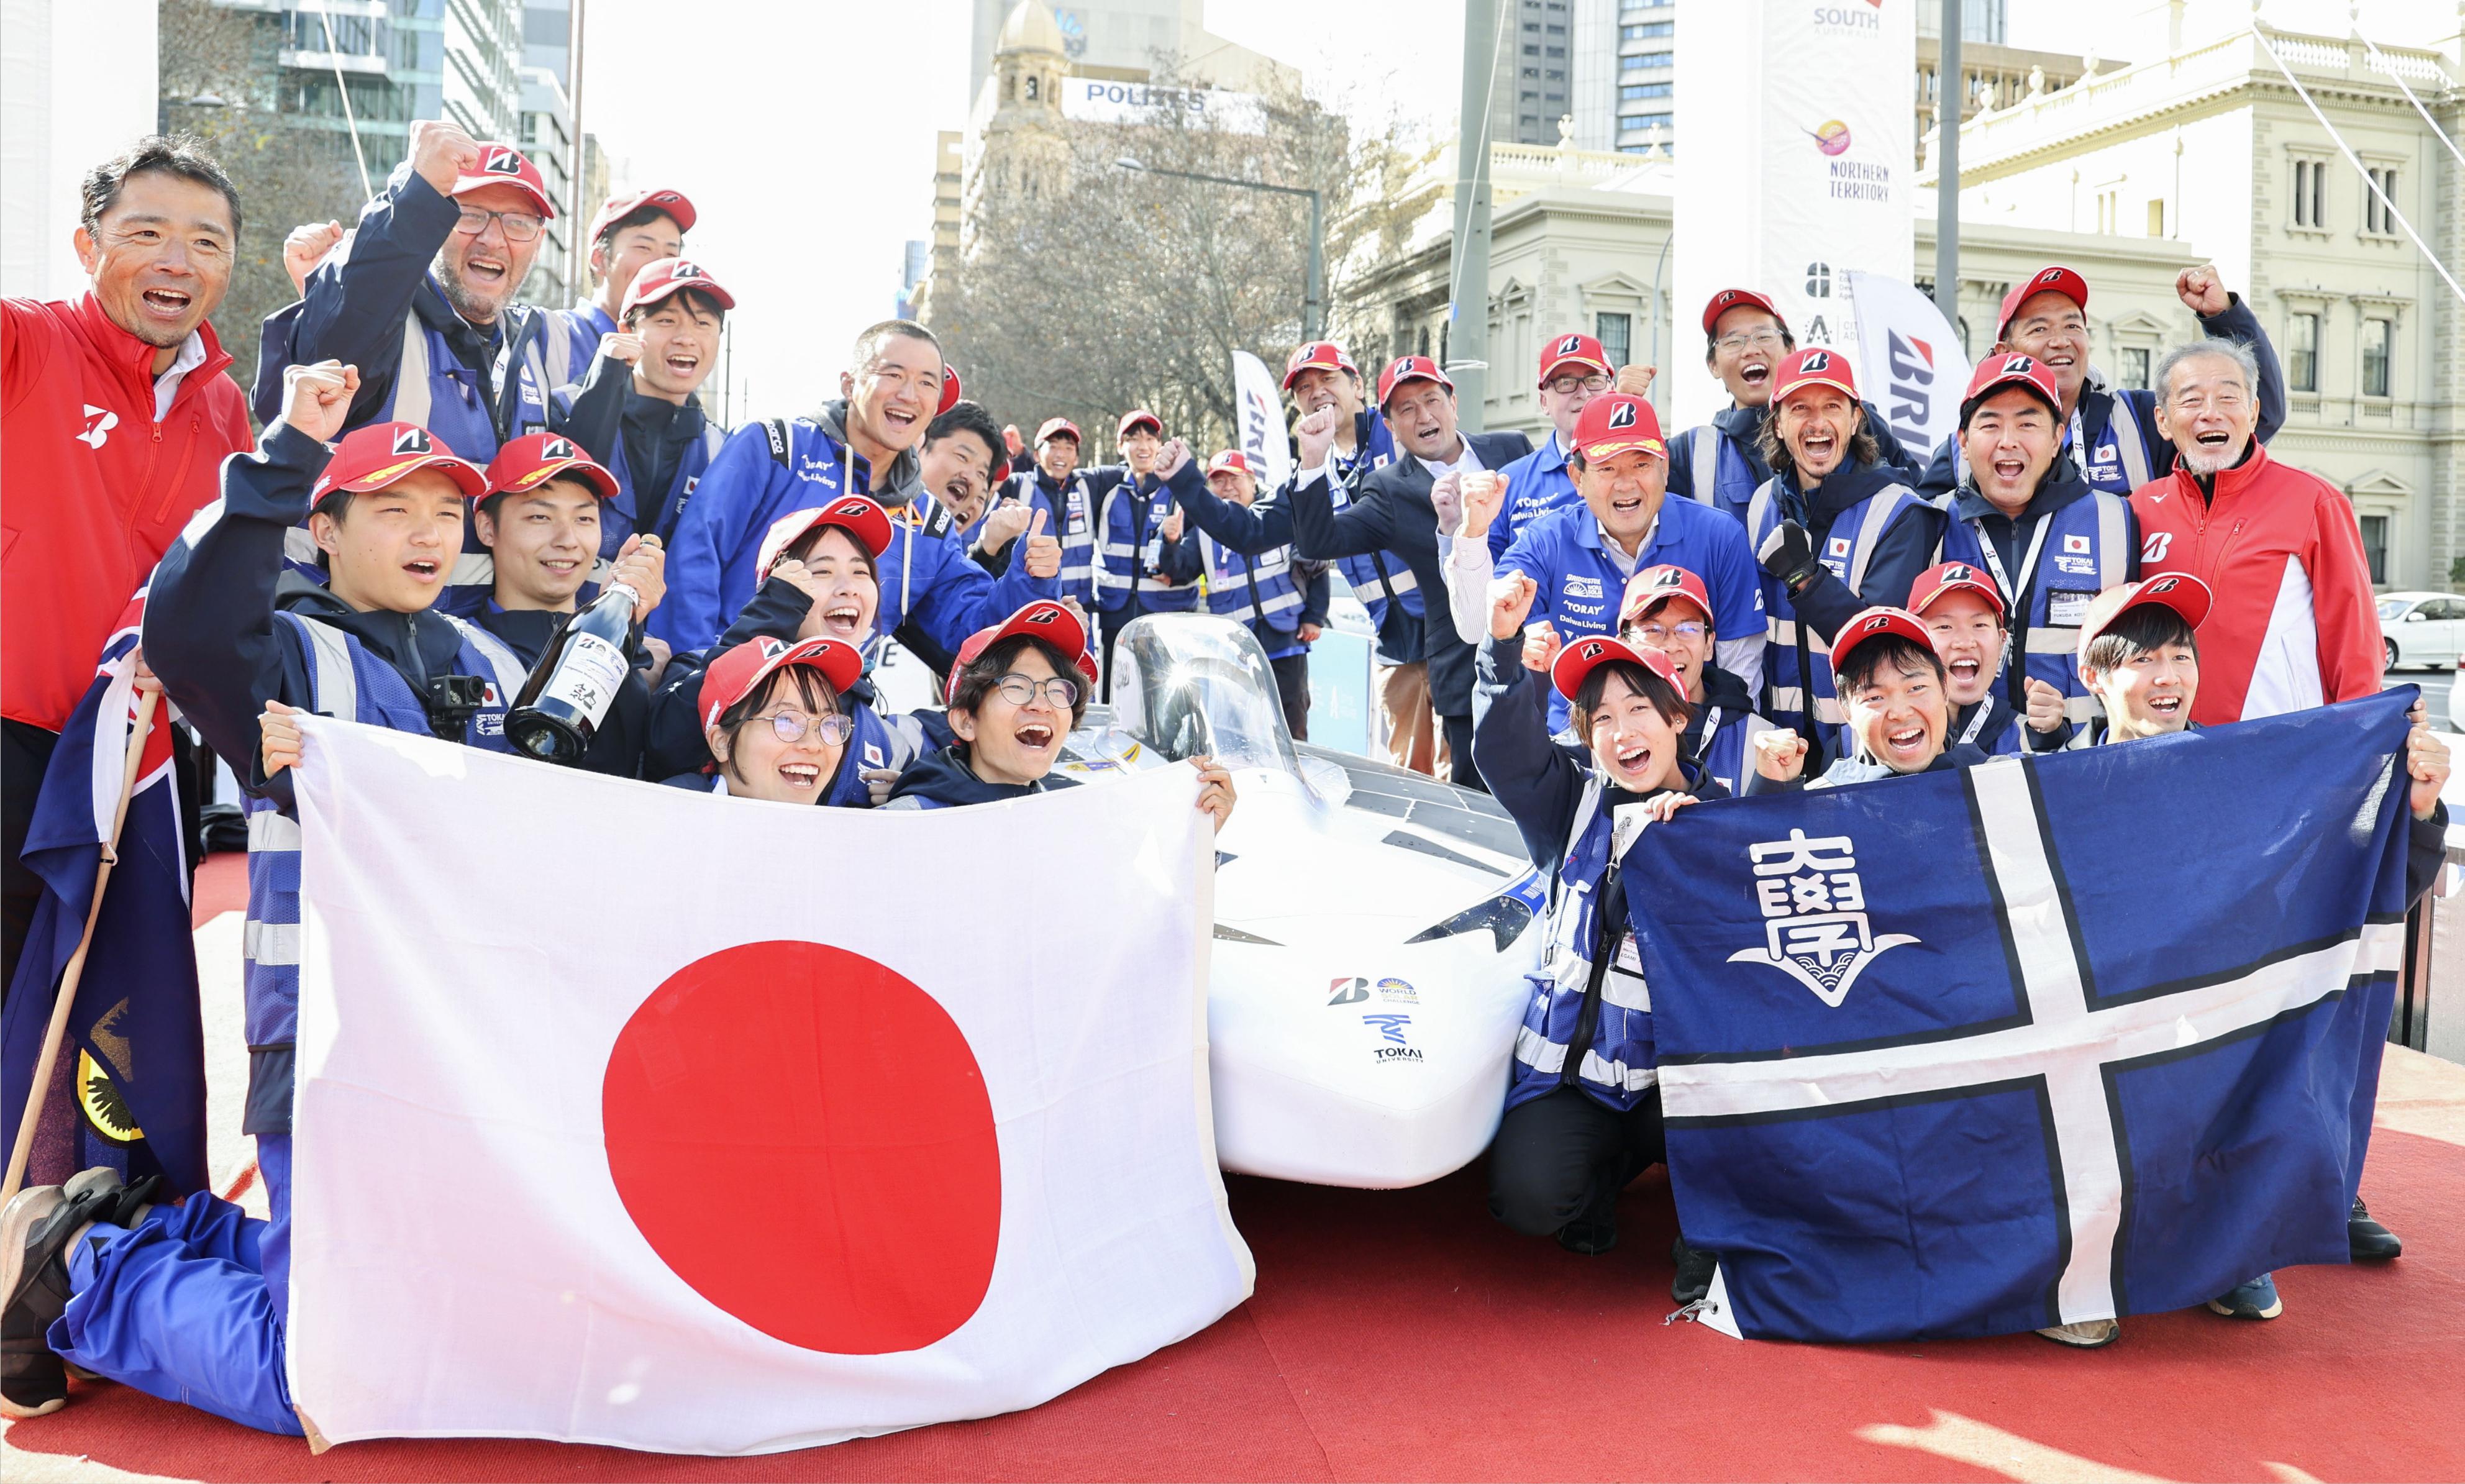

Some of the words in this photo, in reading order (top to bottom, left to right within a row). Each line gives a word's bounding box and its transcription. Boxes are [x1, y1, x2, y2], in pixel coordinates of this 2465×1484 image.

[1813, 8, 1879, 30] SOUTH
[1830, 161, 1889, 183] NORTHERN
[1829, 181, 1889, 203] TERRITORY
[1888, 327, 1934, 466] BRI
[810, 473, 837, 489] Living
[1560, 614, 1582, 627] Daiwa
[1582, 621, 1606, 630] Living
[486, 713, 506, 721] TOKA
[1621, 952, 1636, 962] EGAMI
[1374, 1047, 1423, 1058] TOKAI
[1376, 1056, 1424, 1064] UNIVERSITY
